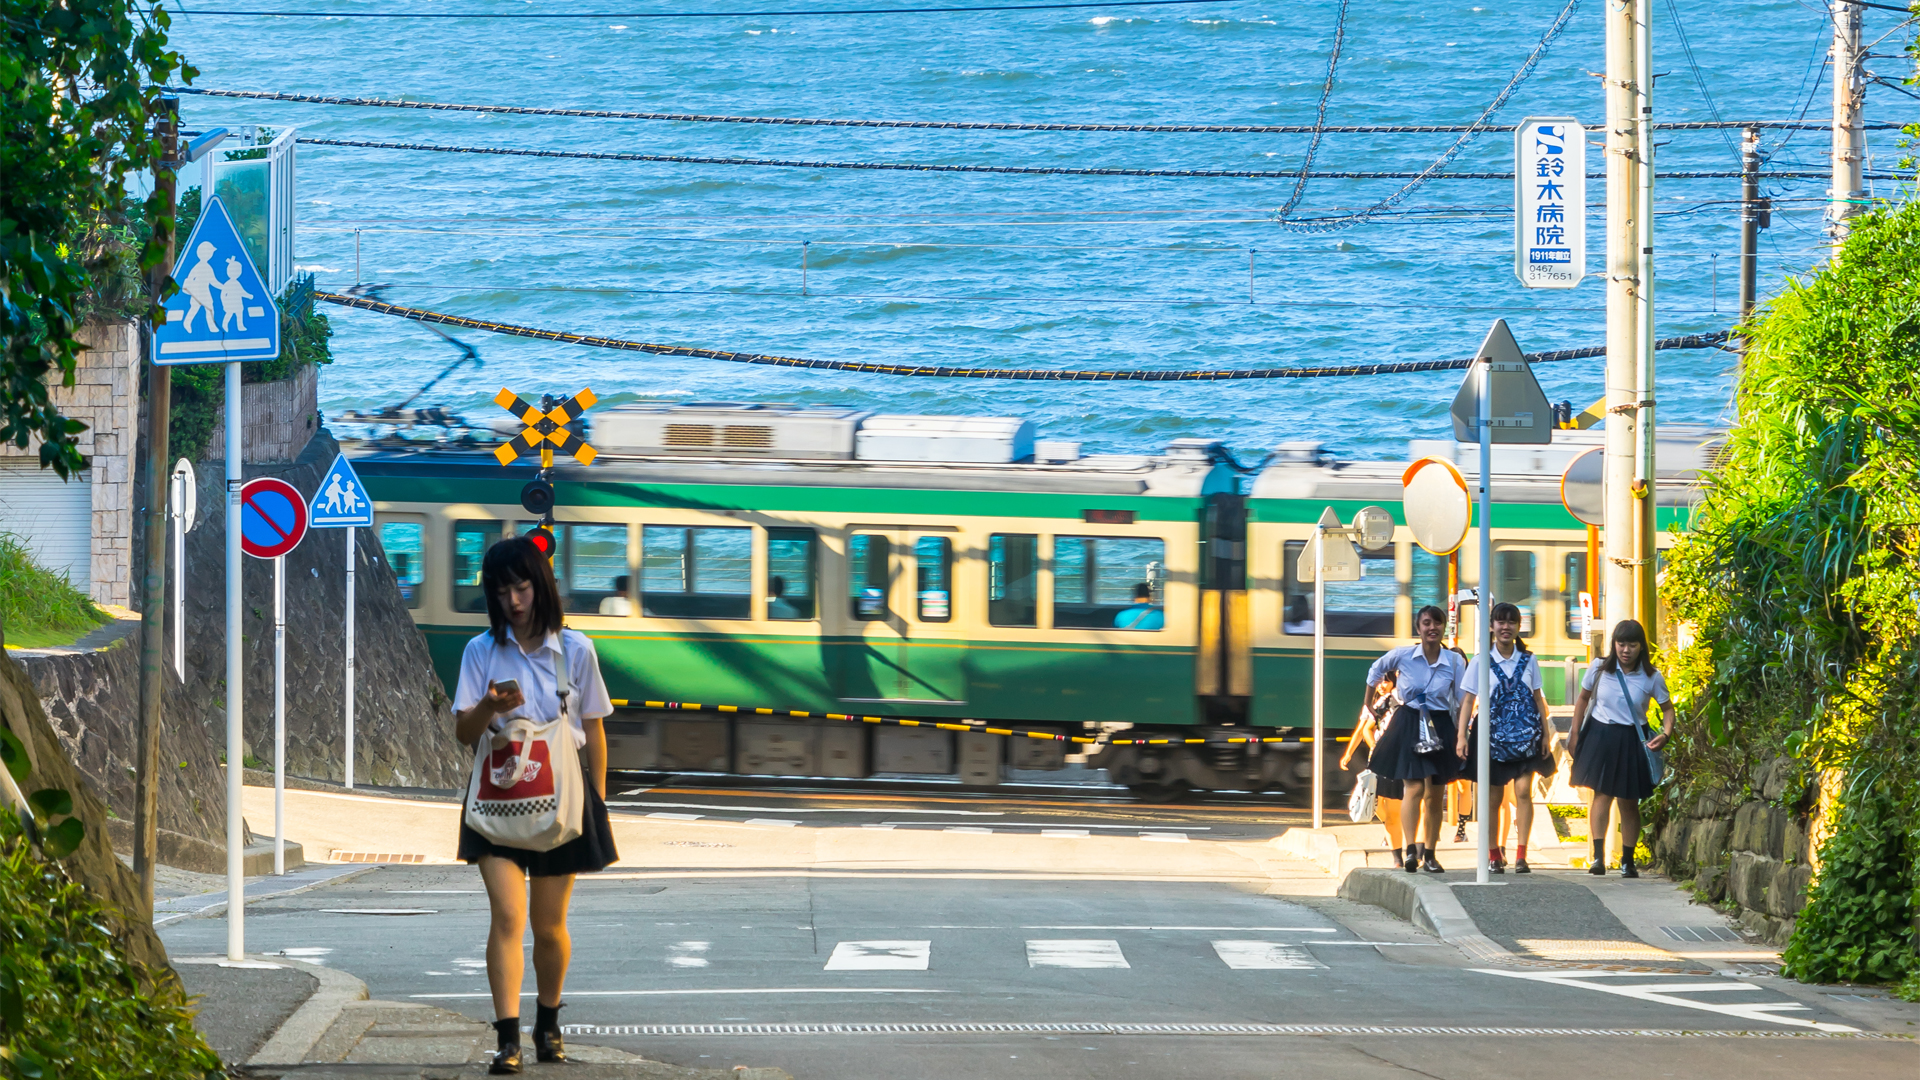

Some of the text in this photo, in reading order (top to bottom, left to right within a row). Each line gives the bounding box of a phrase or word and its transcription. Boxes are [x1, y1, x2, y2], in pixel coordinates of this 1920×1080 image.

[1537, 157, 1564, 245] 鈴木病院
[1529, 265, 1553, 273] 0467
[1529, 273, 1572, 281] 31-7651
